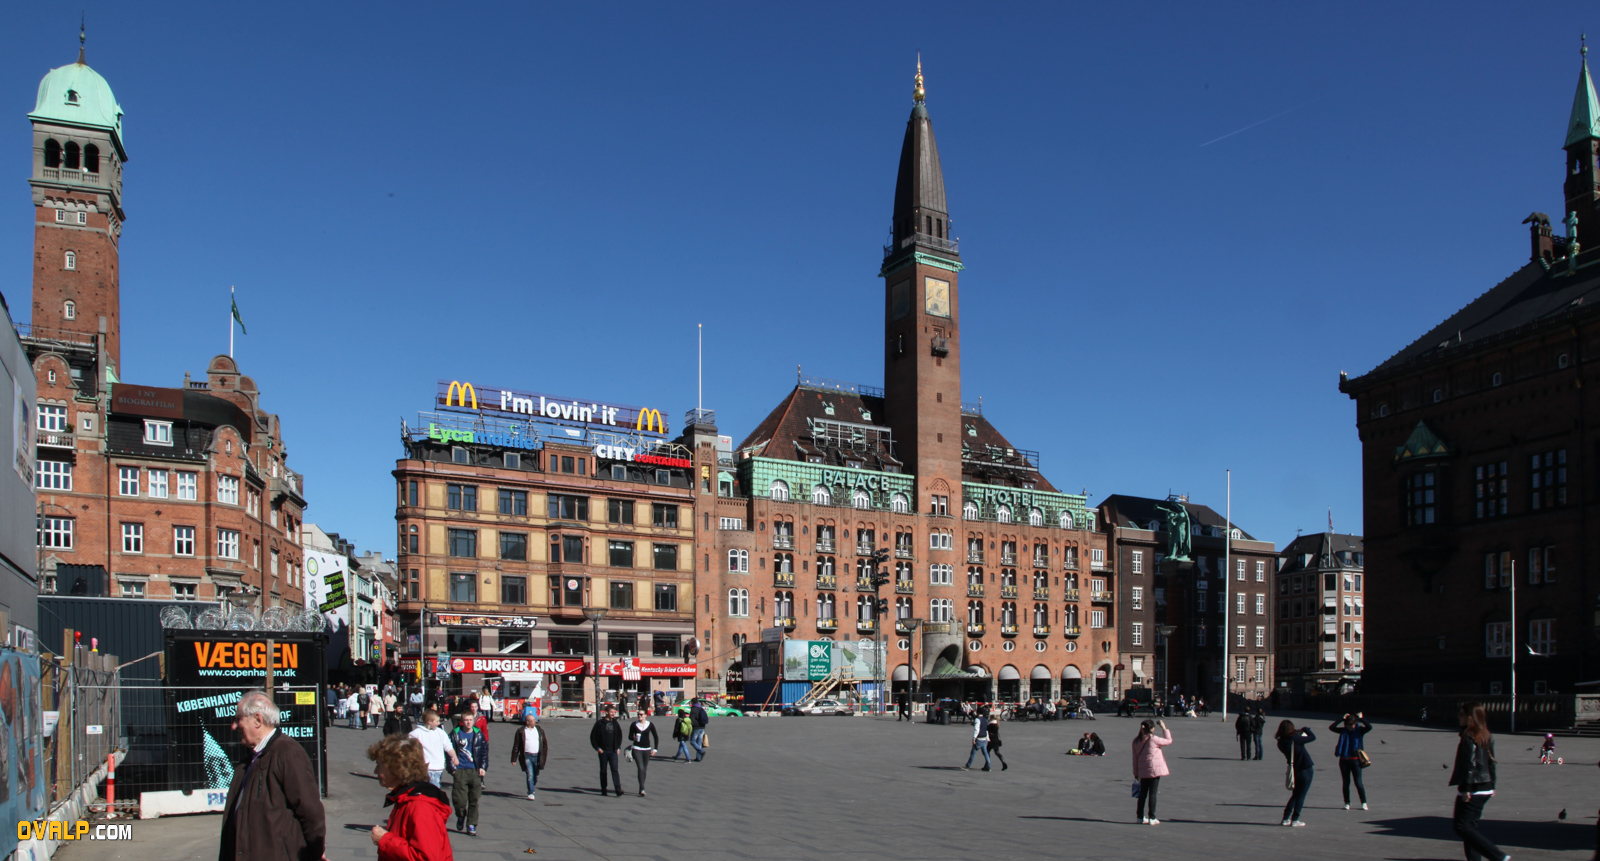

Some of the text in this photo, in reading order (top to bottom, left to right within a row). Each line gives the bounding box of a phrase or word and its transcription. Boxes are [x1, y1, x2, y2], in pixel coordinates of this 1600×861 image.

[500, 390, 534, 415] i'm
[539, 396, 598, 423] lovin'
[429, 423, 536, 450] Lycamobile
[596, 444, 636, 462] CITY
[634, 453, 692, 469] CONTAINER
[821, 469, 890, 492] PALACE
[984, 488, 1039, 508] HOTEL
[194, 641, 299, 669] VÆGGEN
[810, 645, 829, 658] OK
[473, 659, 565, 672] BURGER KING
[592, 662, 621, 675] KFC
[641, 666, 663, 674] Kentucky
[176, 691, 243, 713] KØBENHAVNS
